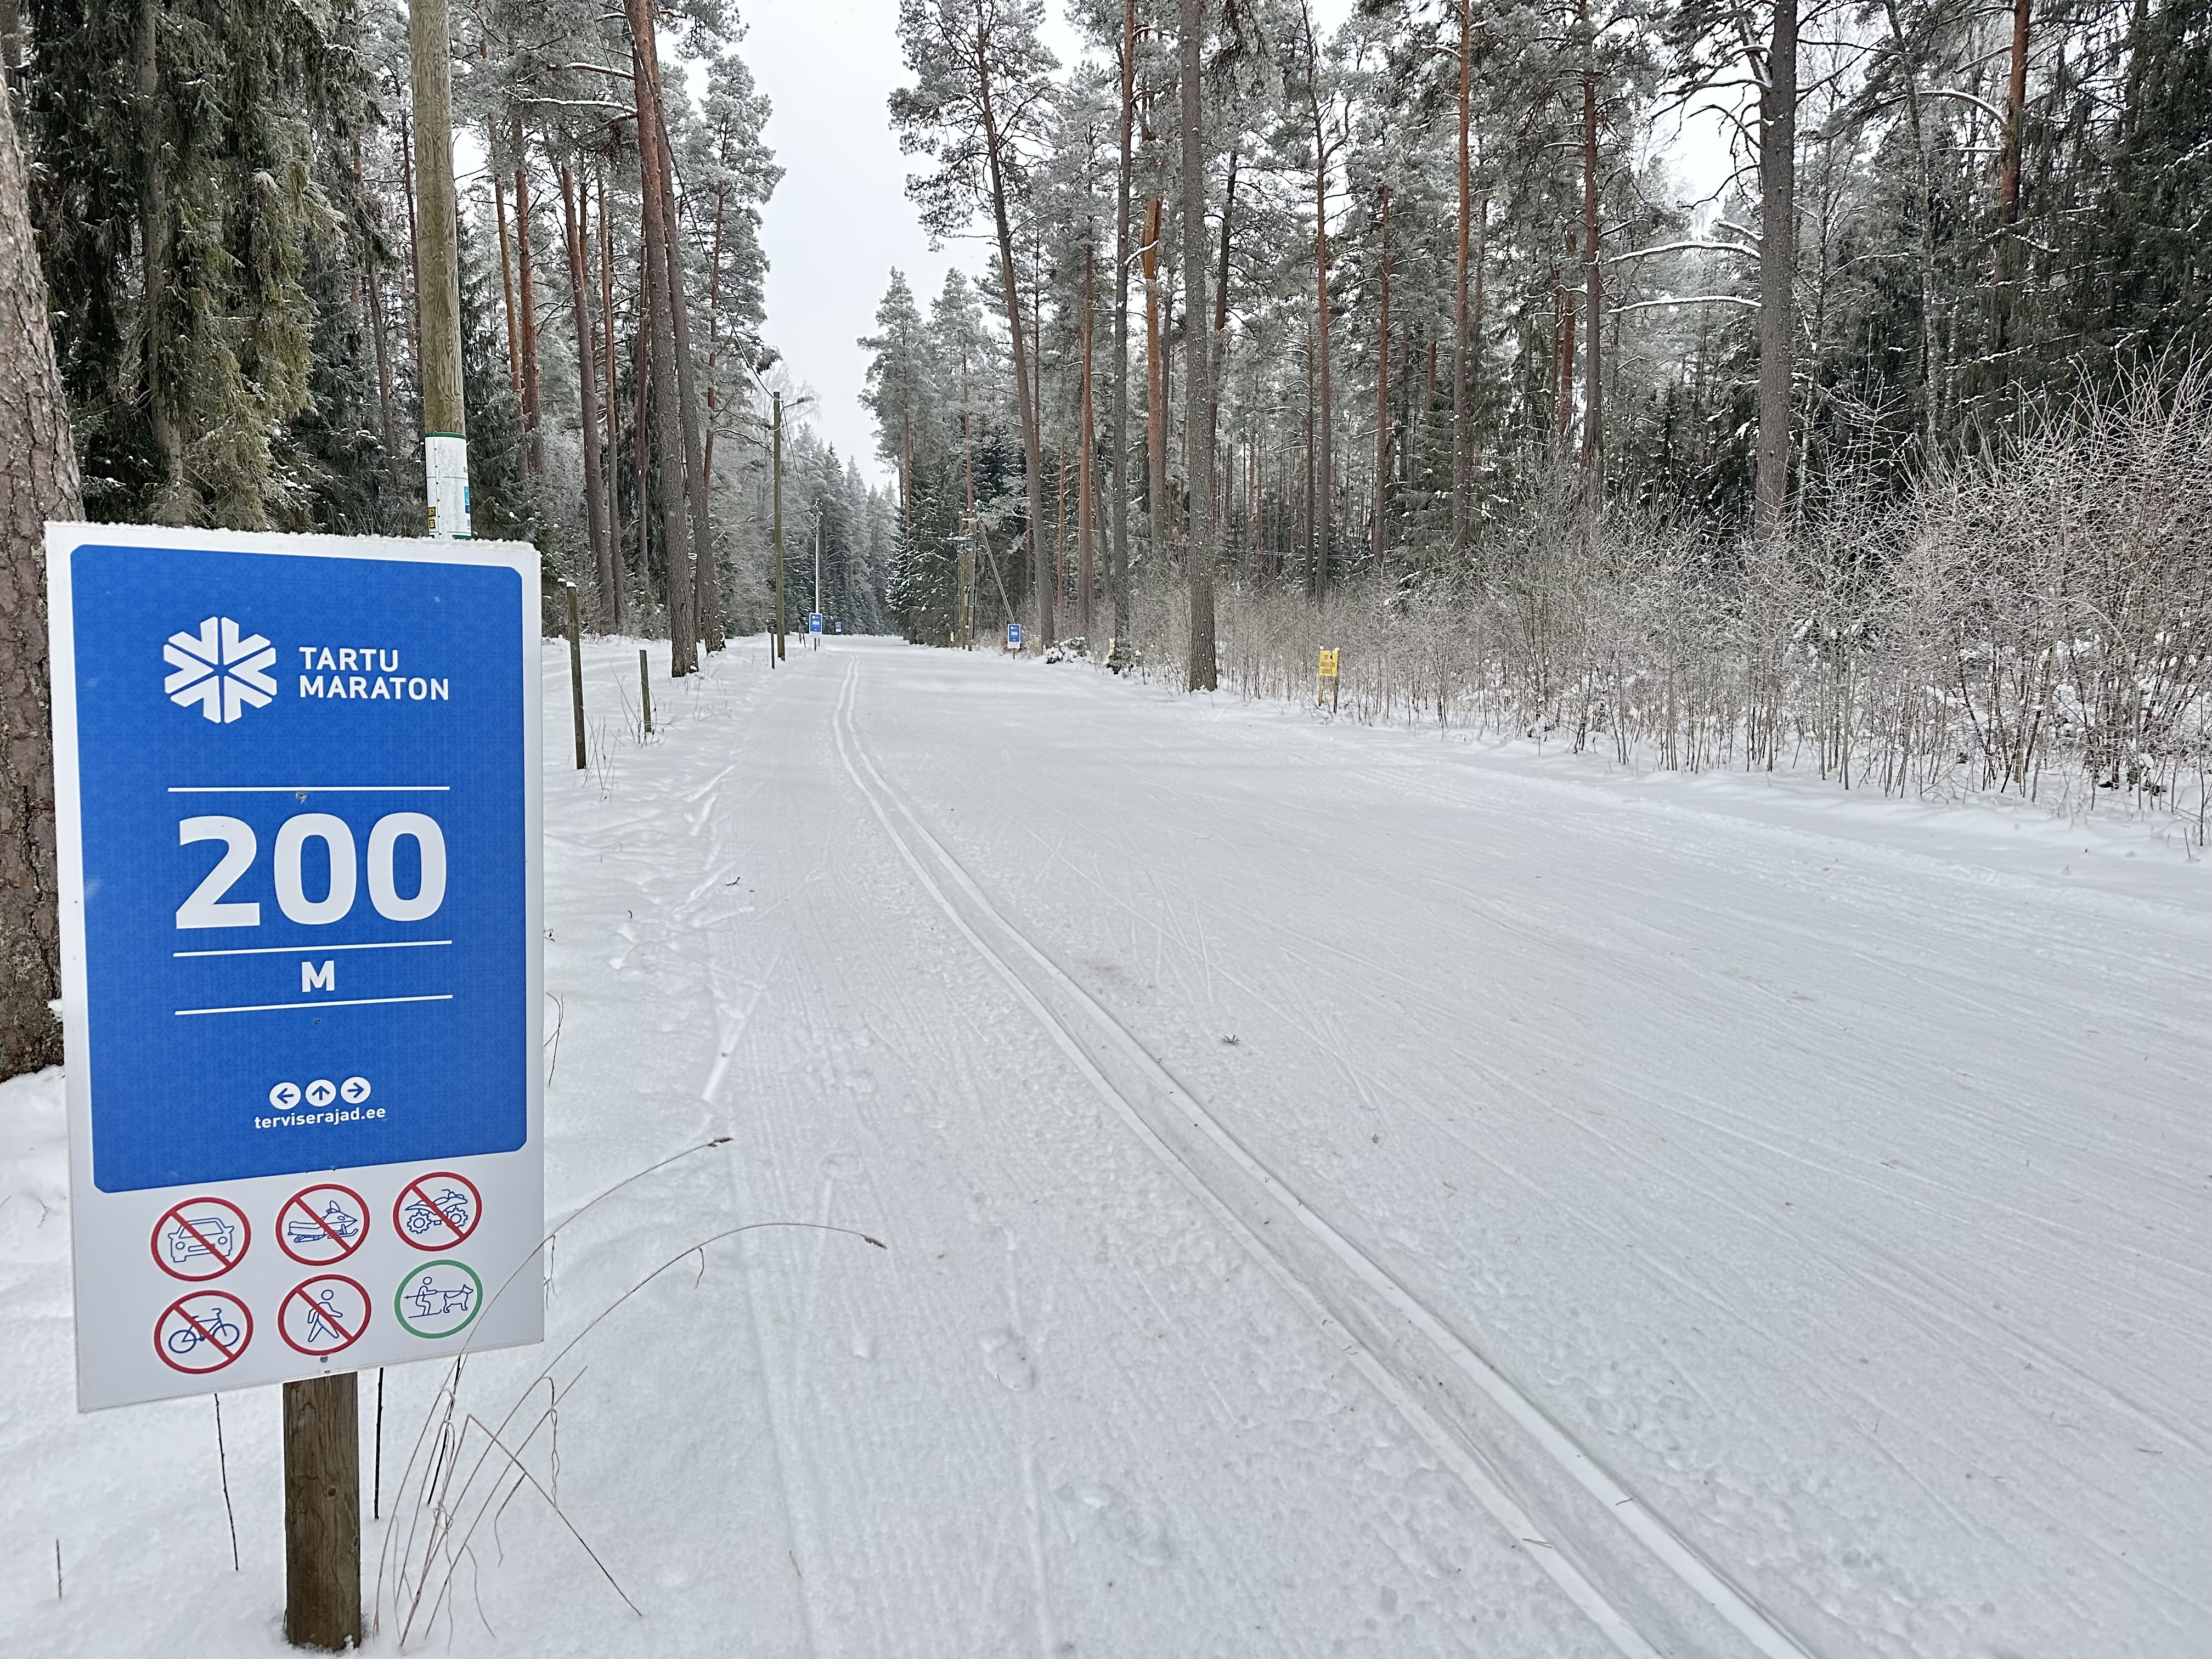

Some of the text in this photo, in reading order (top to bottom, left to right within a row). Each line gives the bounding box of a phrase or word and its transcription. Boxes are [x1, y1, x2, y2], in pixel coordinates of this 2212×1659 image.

[299, 647, 398, 672] TARTU
[299, 675, 449, 701] MARATON
[176, 812, 447, 929] 200
[301, 960, 335, 992] M
[254, 1107, 386, 1129] terviserajad.ee
